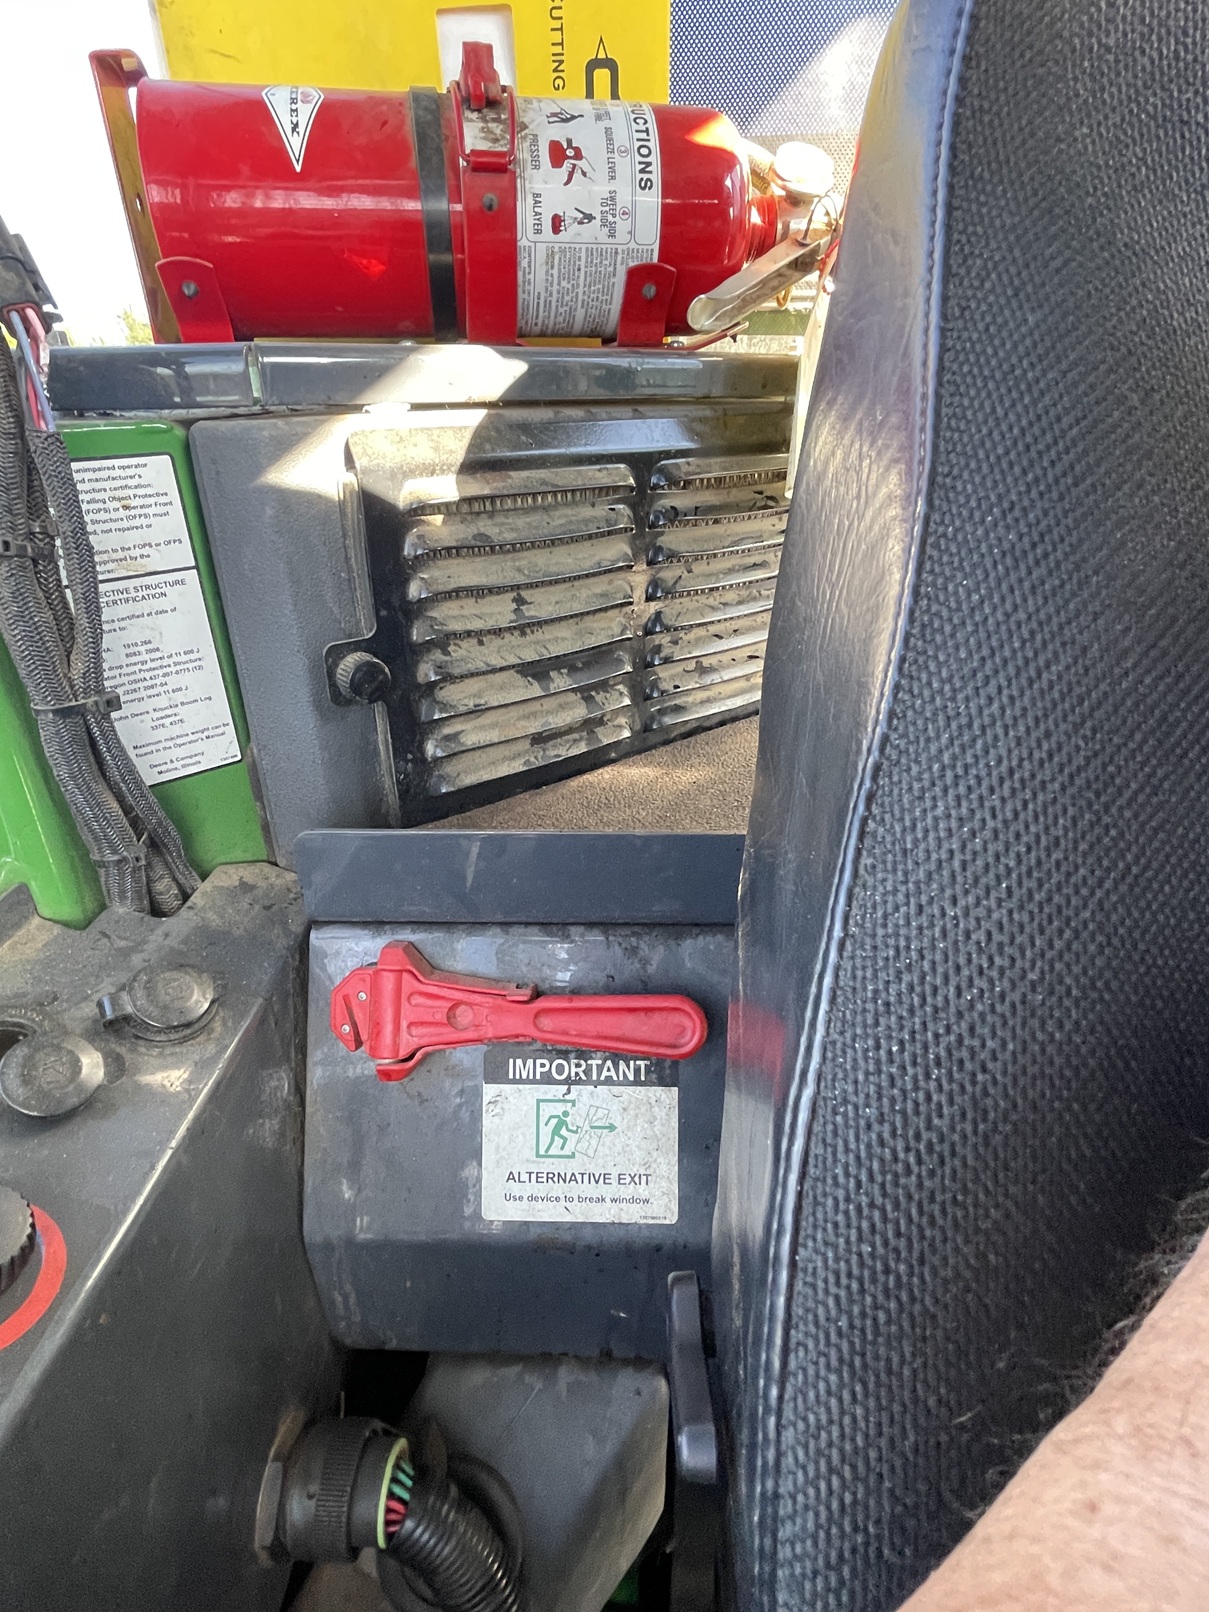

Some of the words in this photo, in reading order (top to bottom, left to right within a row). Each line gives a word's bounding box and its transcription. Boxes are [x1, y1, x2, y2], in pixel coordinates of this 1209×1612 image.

[549, 0, 566, 91] UTTING
[604, 127, 615, 154] SQUEEZE
[529, 134, 540, 170] PRESSER
[608, 157, 616, 183] LEVER.
[600, 197, 608, 207] TO
[608, 190, 617, 218] SWEEP
[533, 193, 542, 235] BALAYER
[600, 210, 608, 231] SIDE.
[608, 221, 616, 239] SIDE
[74, 465, 115, 473] unimpaired
[117, 462, 147, 471] operator
[88, 473, 142, 483] manufacturer's
[109, 483, 153, 492] certification:
[108, 495, 132, 503] Object
[133, 491, 168, 500] Protective
[84, 507, 111, 516] (FOPS)
[122, 504, 153, 512] Operator
[90, 517, 124, 525] Structure
[126, 512, 151, 522] (OFPS)
[101, 527, 113, 535] not
[115, 524, 143, 533] repaired
[133, 542, 153, 550] FOPS
[133, 578, 187, 593] STRUCTURE
[100, 591, 167, 609] CERTIFICATION
[117, 613, 145, 622] certified
[108, 664, 123, 672] drop
[125, 660, 148, 669] energy
[149, 655, 165, 663] level
[119, 671, 137, 679] Front
[138, 664, 171, 674] Protective
[173, 657, 204, 667] Structure:
[128, 677, 148, 685] OSHA
[122, 696, 145, 705] energy
[146, 691, 162, 699] level
[130, 710, 150, 719] Deere
[153, 703, 179, 713] Knuckle
[180, 698, 199, 707] Boom
[200, 695, 212, 703] Log
[133, 739, 163, 751] Maximum
[164, 732, 190, 742] machine
[191, 727, 210, 737] weight
[136, 750, 154, 758] found
[173, 736, 204, 749] Operator's
[205, 731, 226, 740] Manual
[149, 761, 168, 770] Deere
[176, 751, 205, 763] Company
[157, 766, 180, 776] Moline,
[181, 760, 202, 769] Illinois
[508, 1058, 650, 1081] IMPORTANT
[506, 1171, 612, 1185] ALTERNATIVE
[617, 1173, 652, 1186] EXIT
[504, 1192, 524, 1202] Use
[527, 1192, 561, 1203] device
[564, 1195, 574, 1203] to
[577, 1194, 607, 1204] break
[610, 1194, 653, 1205] window.
